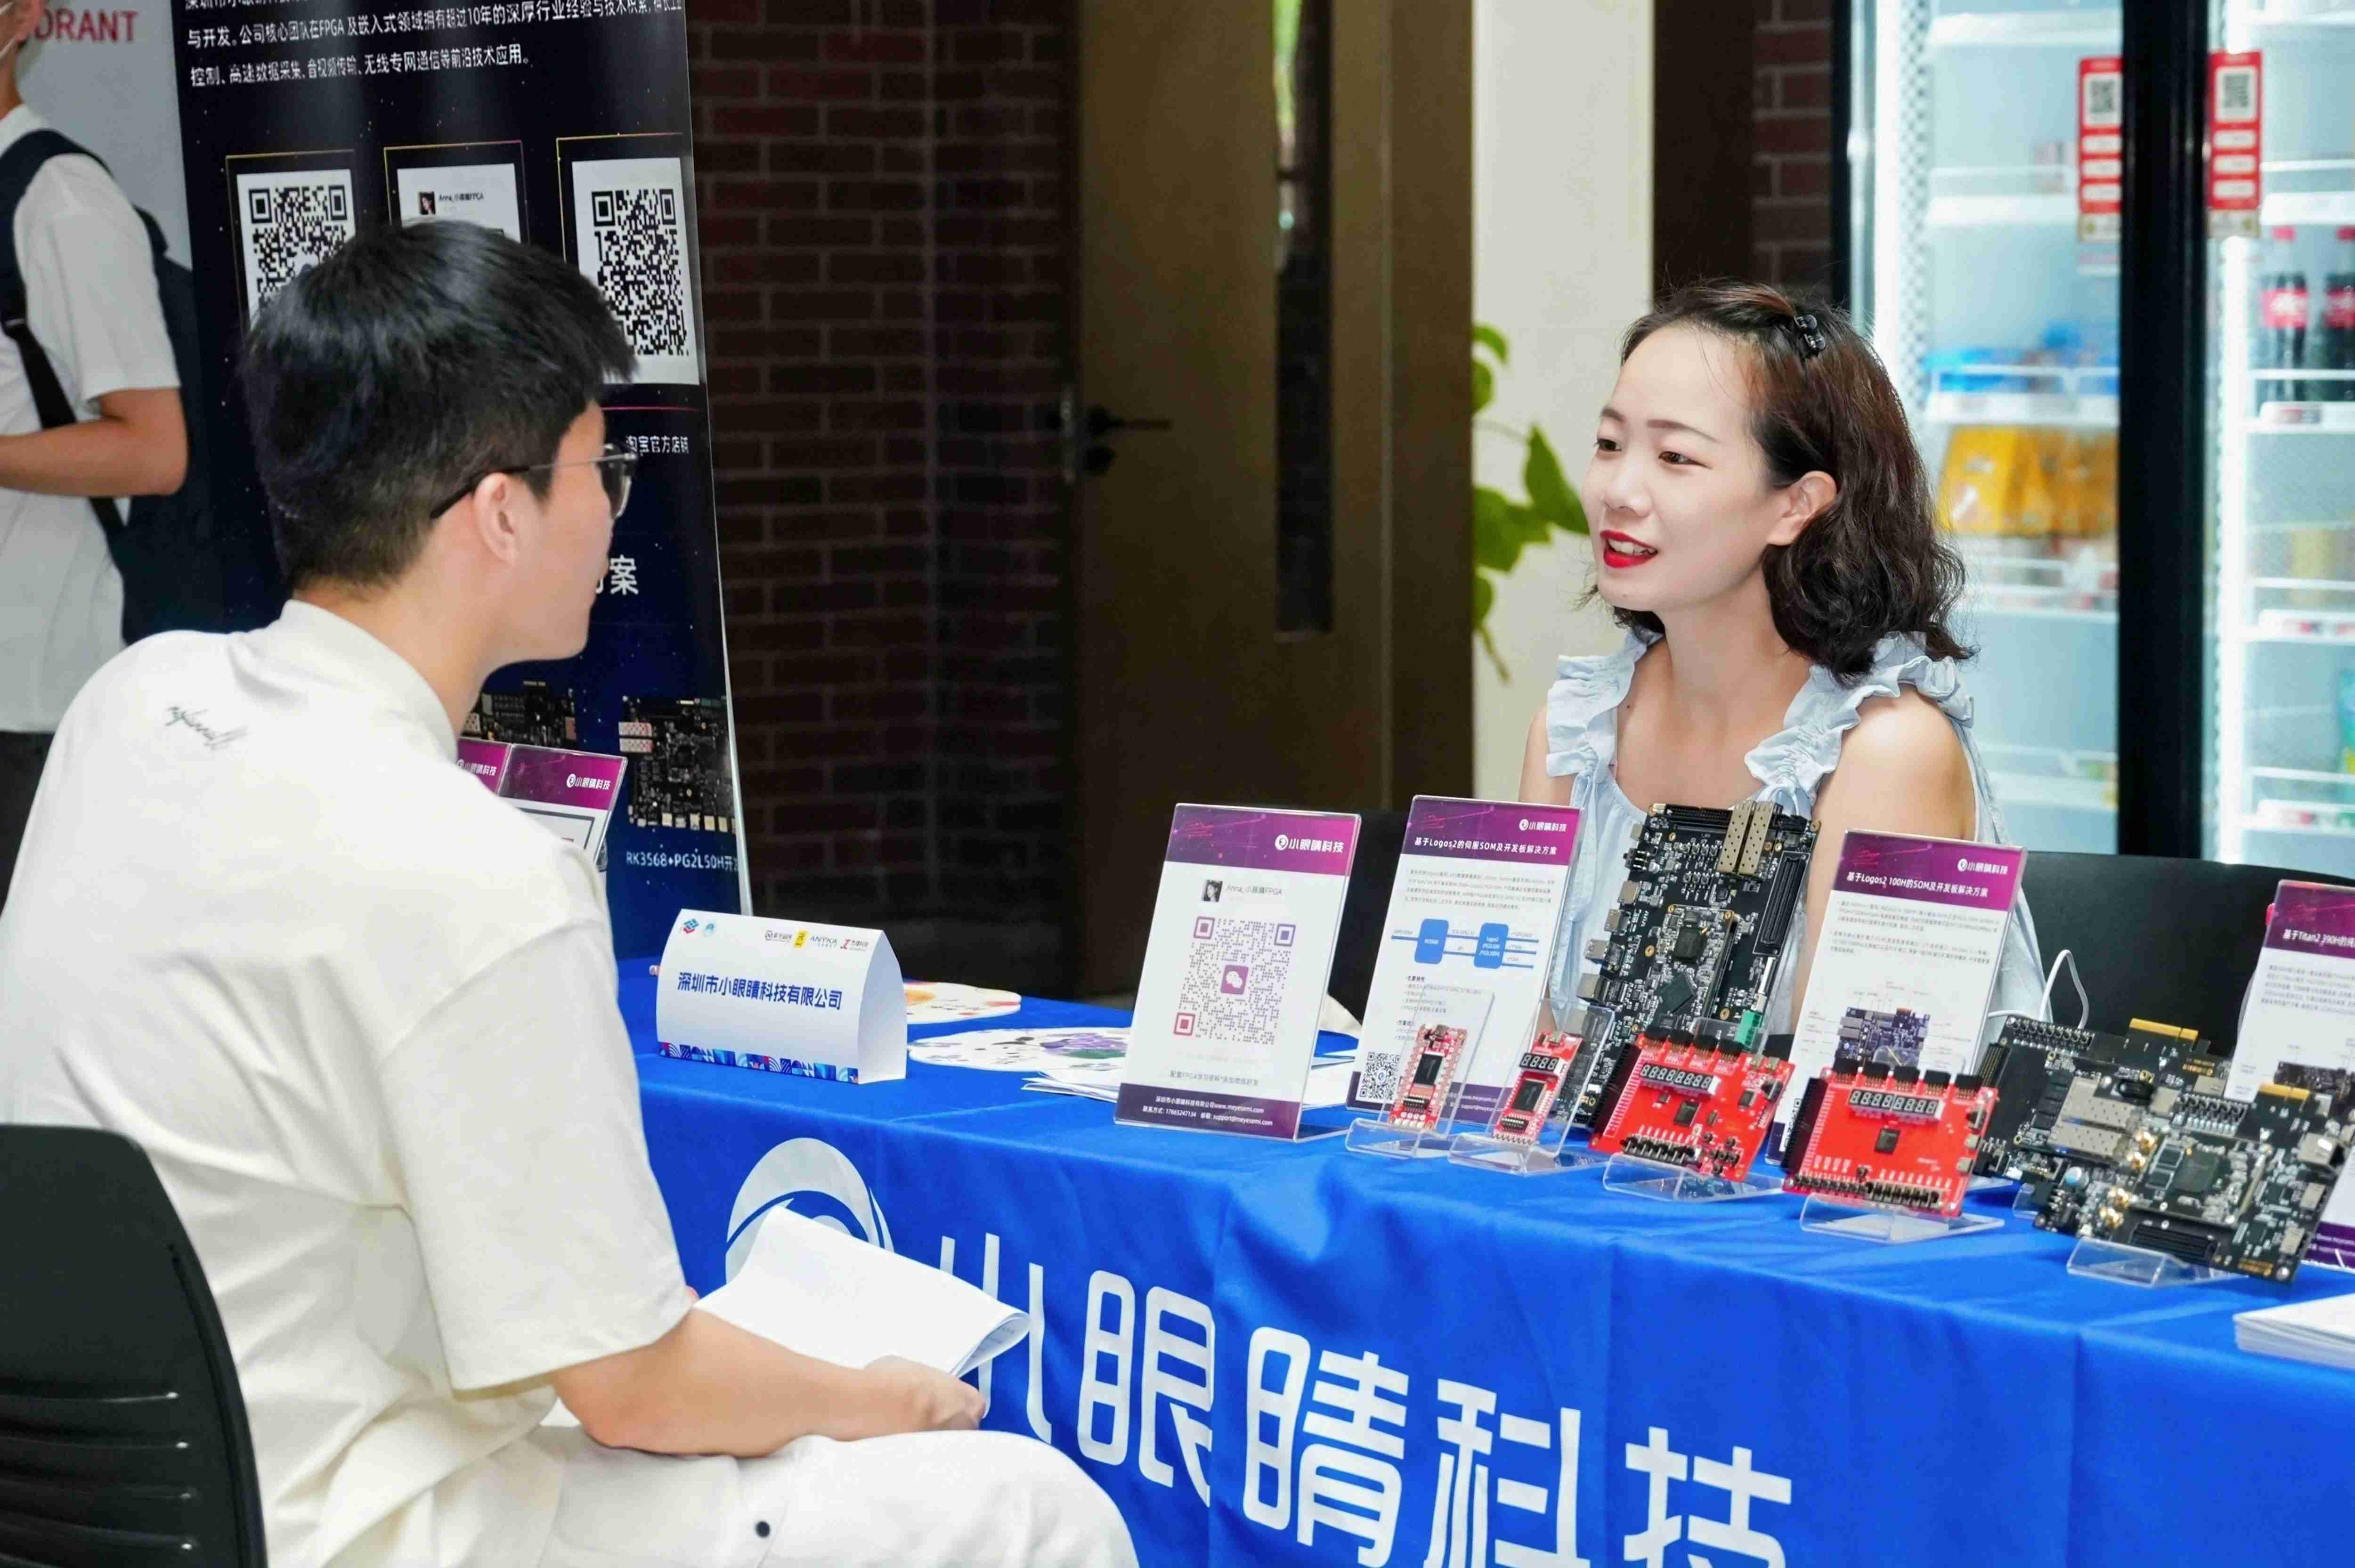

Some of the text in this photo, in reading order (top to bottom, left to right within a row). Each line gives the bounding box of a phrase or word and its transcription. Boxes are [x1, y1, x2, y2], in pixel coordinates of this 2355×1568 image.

[575, 776, 611, 790] 小眼睛科技
[1529, 821, 1567, 832] 小眼睛科技
[1288, 837, 1345, 853] 小眼睛科技
[1967, 861, 2009, 875] 小眼睛科技
[810, 935, 837, 944] ANYKA
[677, 971, 843, 1010] 深圳市小眼睛科技有限公司
[936, 1232, 1792, 1568] 小眼睛科技
